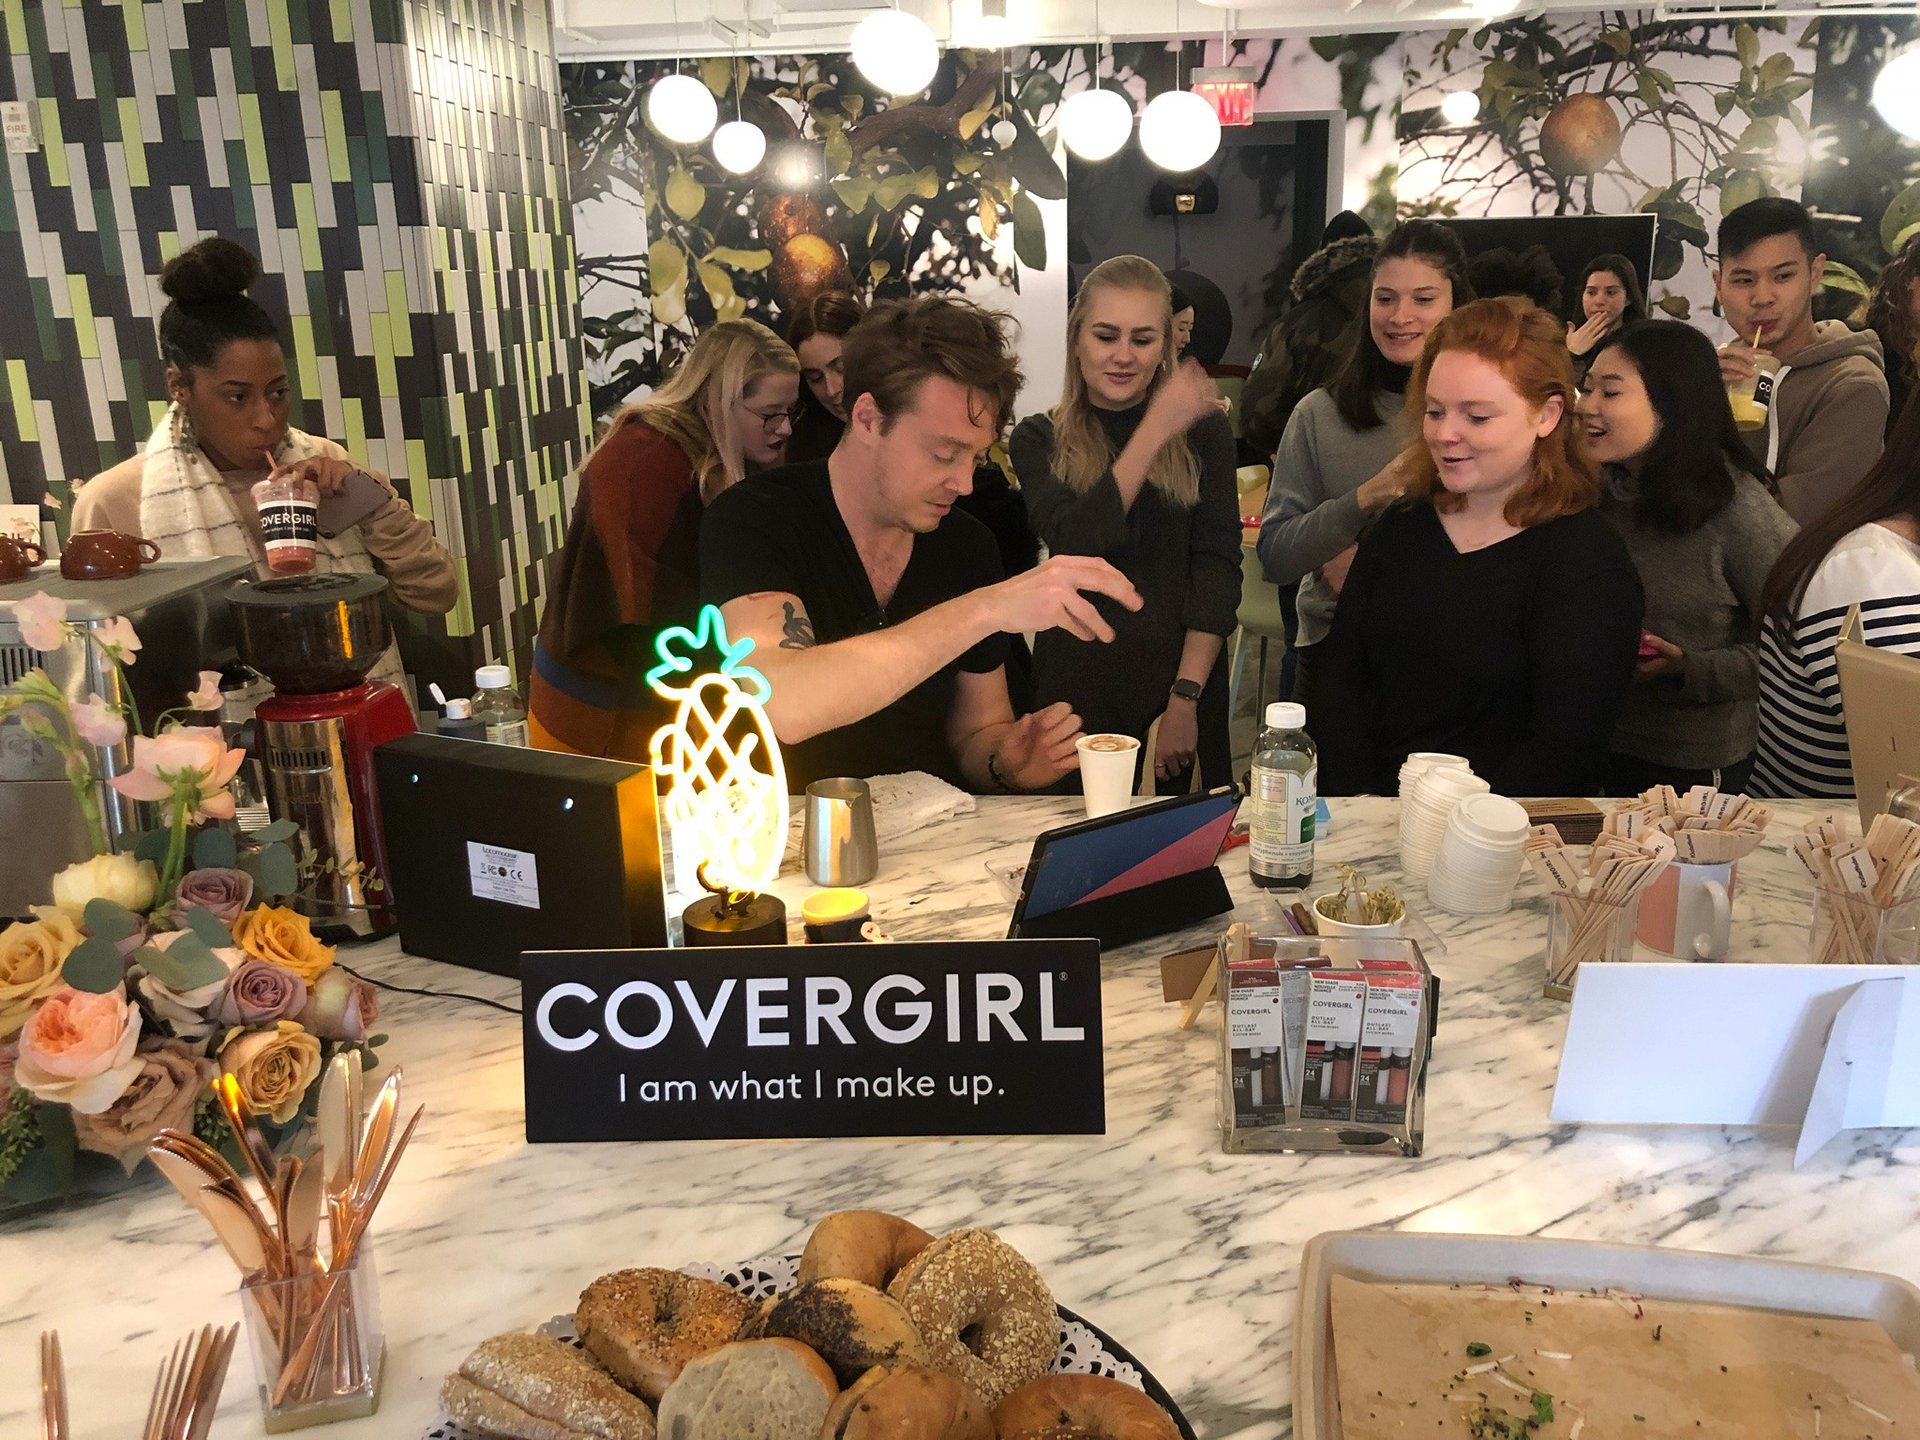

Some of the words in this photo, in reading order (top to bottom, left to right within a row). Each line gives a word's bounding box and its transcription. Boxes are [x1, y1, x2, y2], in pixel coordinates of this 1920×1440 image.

[6, 124, 27, 134] FIRE
[1312, 1000, 1352, 1009] COVERGIRL
[1368, 1008, 1408, 1016] COVERGIRL
[619, 1073, 625, 1102] I
[640, 1078, 697, 1101] am
[709, 1071, 802, 1099] what
[815, 1070, 821, 1098] I
[837, 1068, 935, 1097] make
[949, 1075, 1006, 1104] up.
